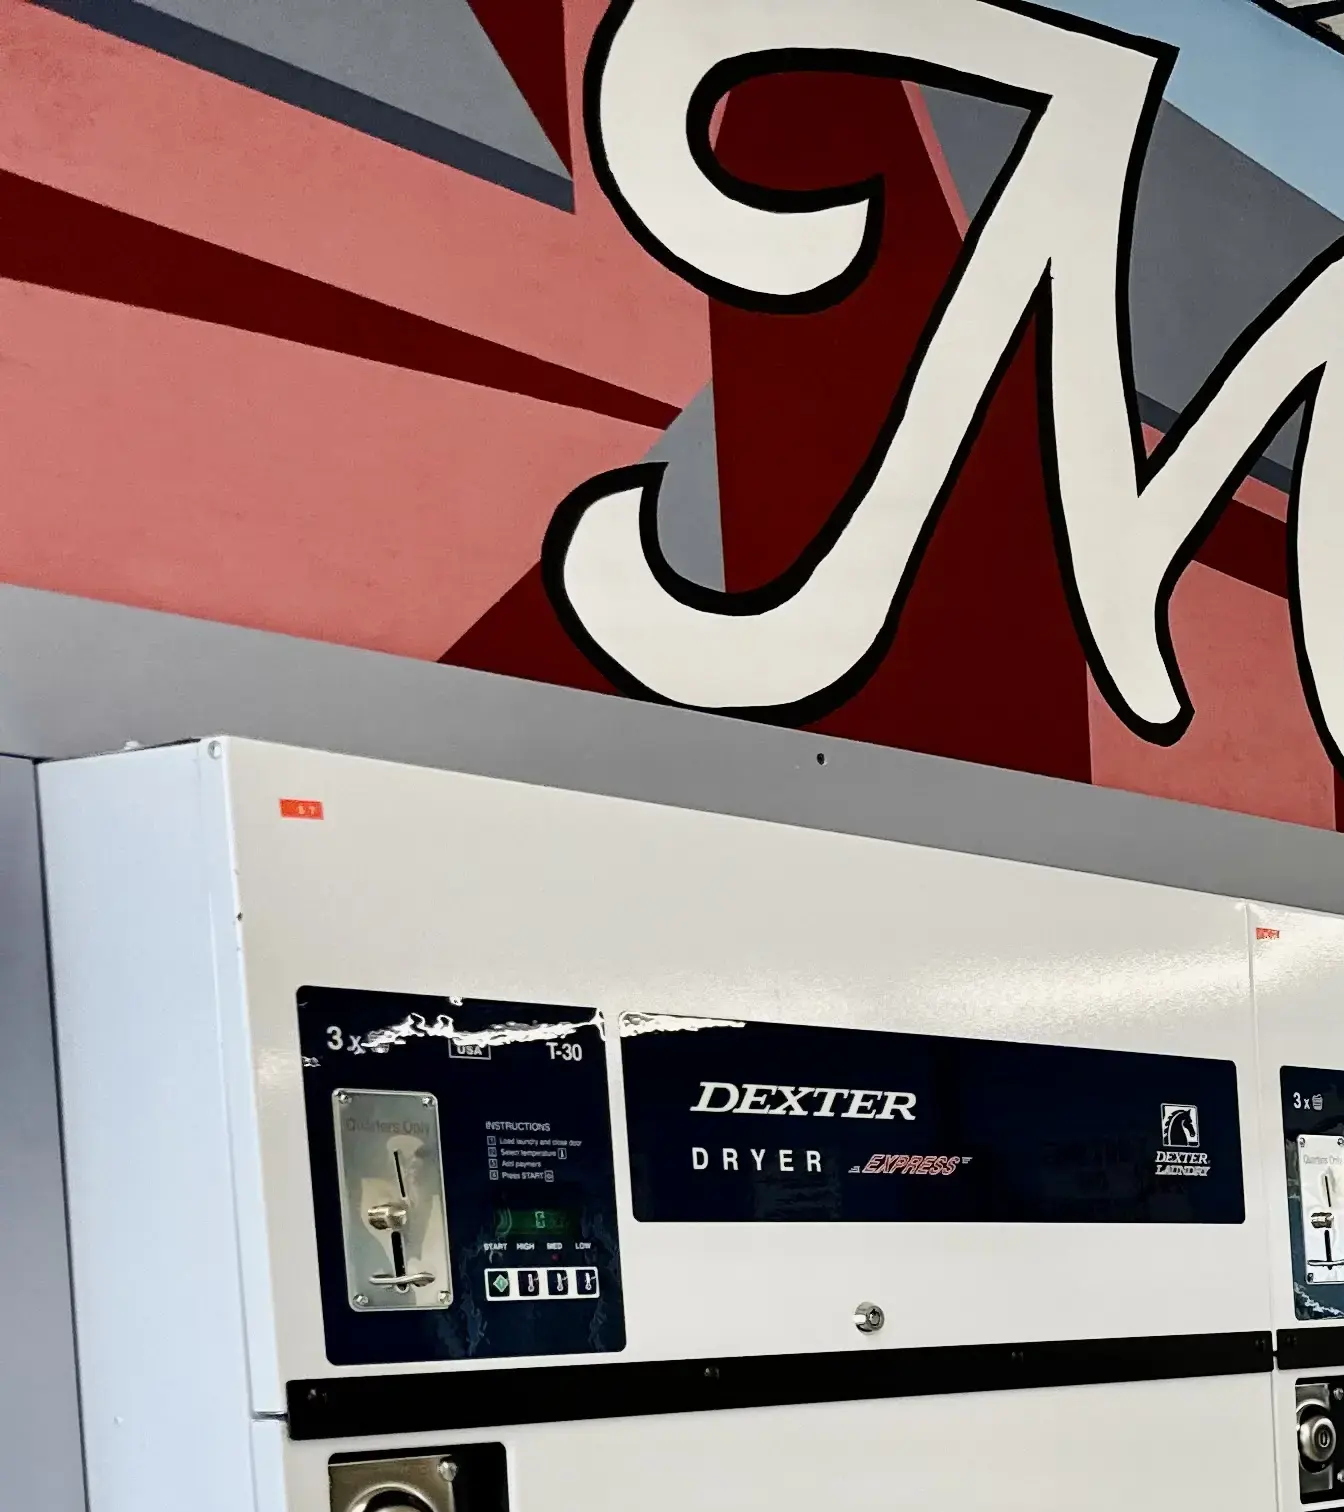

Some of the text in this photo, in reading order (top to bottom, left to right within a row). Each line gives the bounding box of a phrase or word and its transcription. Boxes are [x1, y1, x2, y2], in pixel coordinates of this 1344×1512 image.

[326, 1026, 343, 1050] 3
[546, 1042, 582, 1062] T-30
[690, 1081, 917, 1121] DEXTER
[1293, 1092, 1301, 1108] 3
[486, 1121, 550, 1131] INSTRUCTIONS
[692, 1147, 960, 1175] DRYER EXPRESS
[1155, 1151, 1209, 1164] DEXTER
[1155, 1165, 1210, 1177] LAUNDRY
